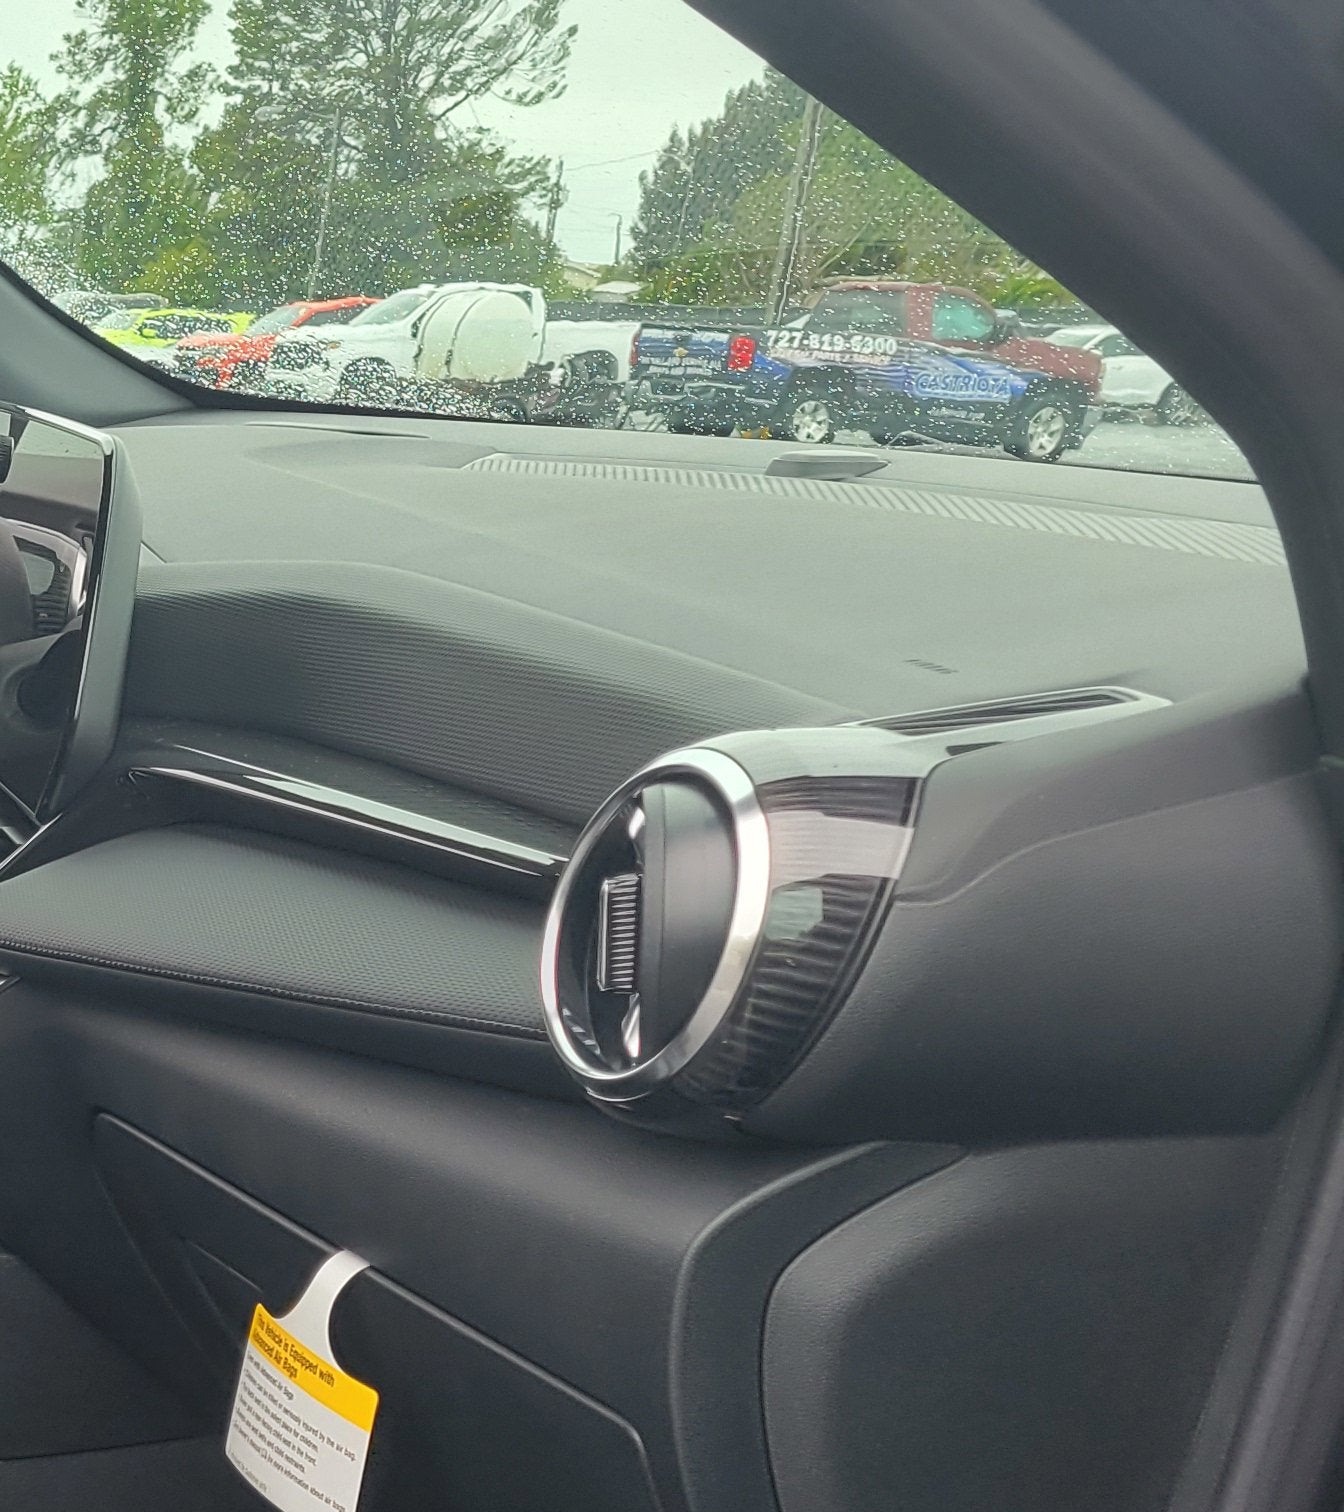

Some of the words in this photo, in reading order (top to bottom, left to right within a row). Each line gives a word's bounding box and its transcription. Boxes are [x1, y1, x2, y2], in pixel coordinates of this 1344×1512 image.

[915, 373, 1011, 395] CASTRIOTA
[266, 1324, 283, 1348] Vehicle
[283, 1338, 288, 1352] is
[289, 1344, 318, 1375] Equipped
[318, 1366, 334, 1387] with
[274, 1350, 282, 1365] Air
[282, 1358, 298, 1378] Bags
[302, 1420, 318, 1437] injured
[319, 1432, 325, 1443] by
[326, 1436, 335, 1448] the
[336, 1444, 344, 1454] air
[284, 1469, 309, 1490] information
[310, 1485, 324, 1501] about
